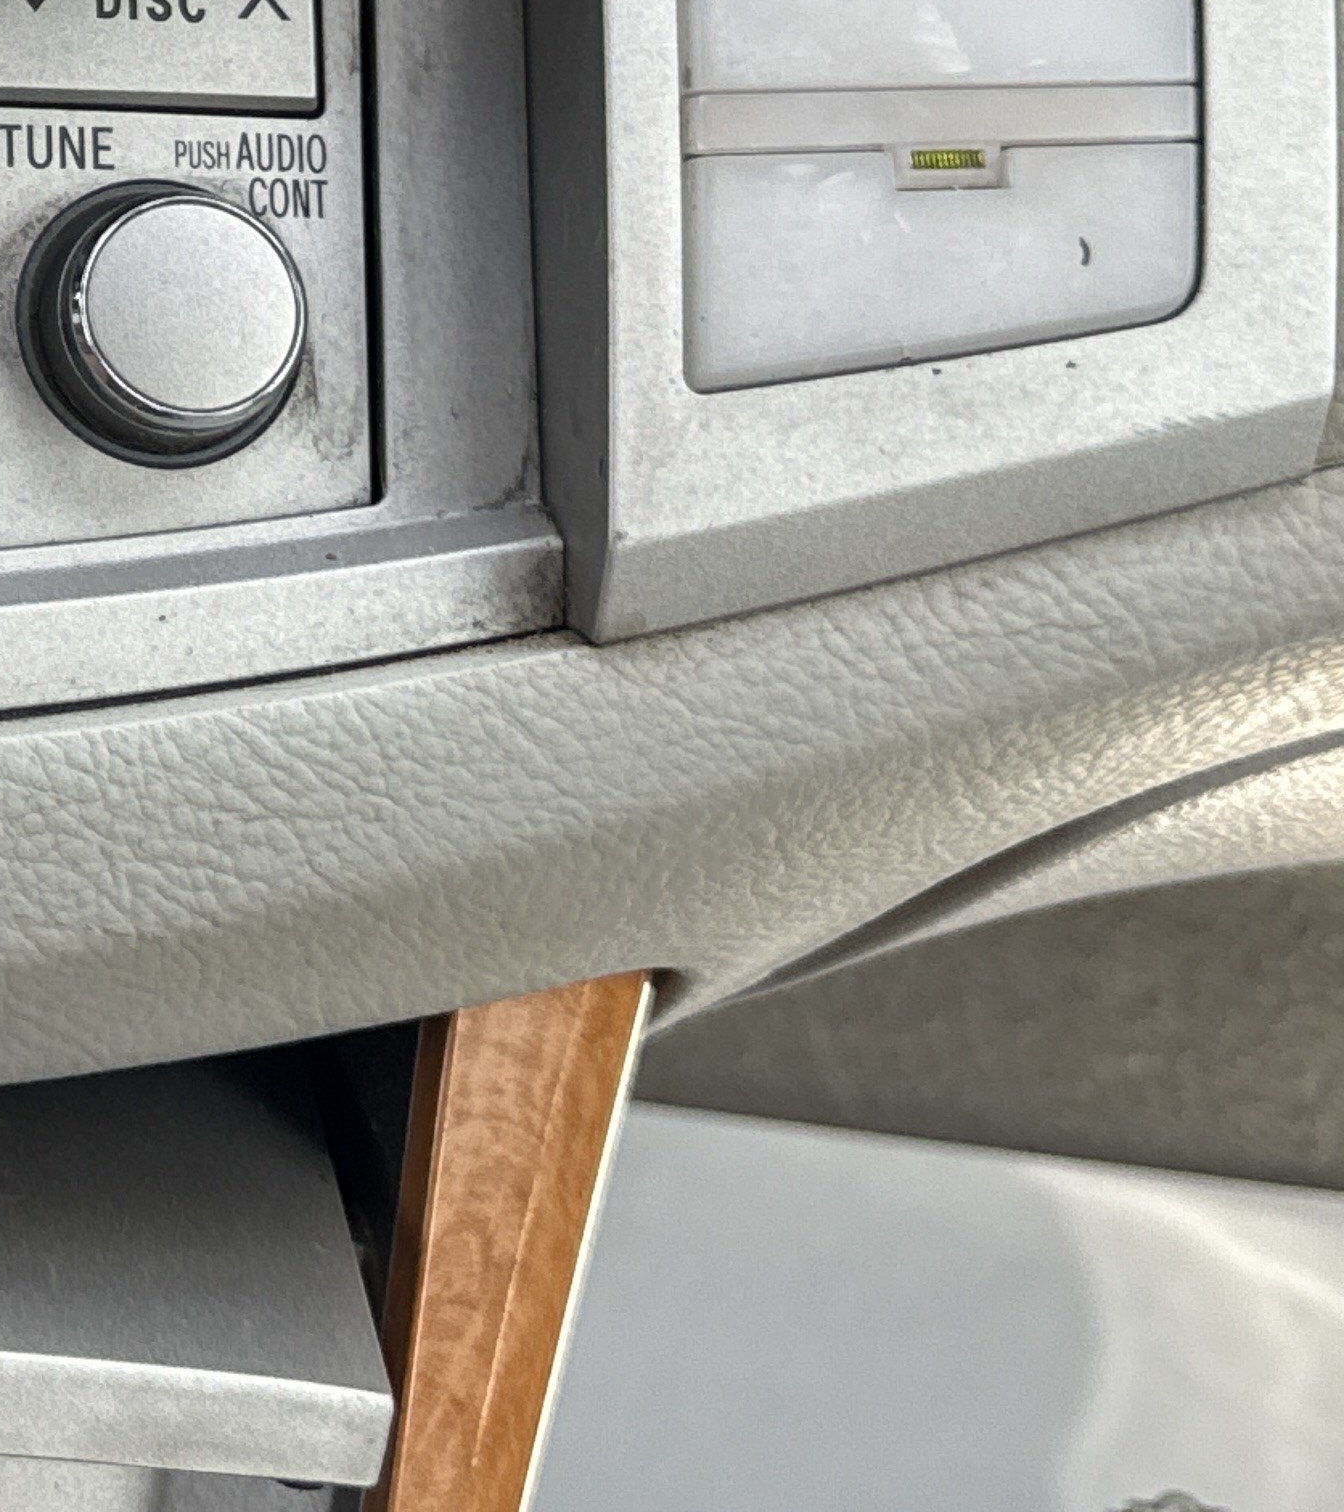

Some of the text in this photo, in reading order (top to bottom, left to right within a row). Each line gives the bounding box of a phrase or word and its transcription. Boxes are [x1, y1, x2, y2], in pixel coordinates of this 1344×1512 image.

[174, 132, 328, 175] PUSH AUDIO
[247, 177, 329, 221] CONT
